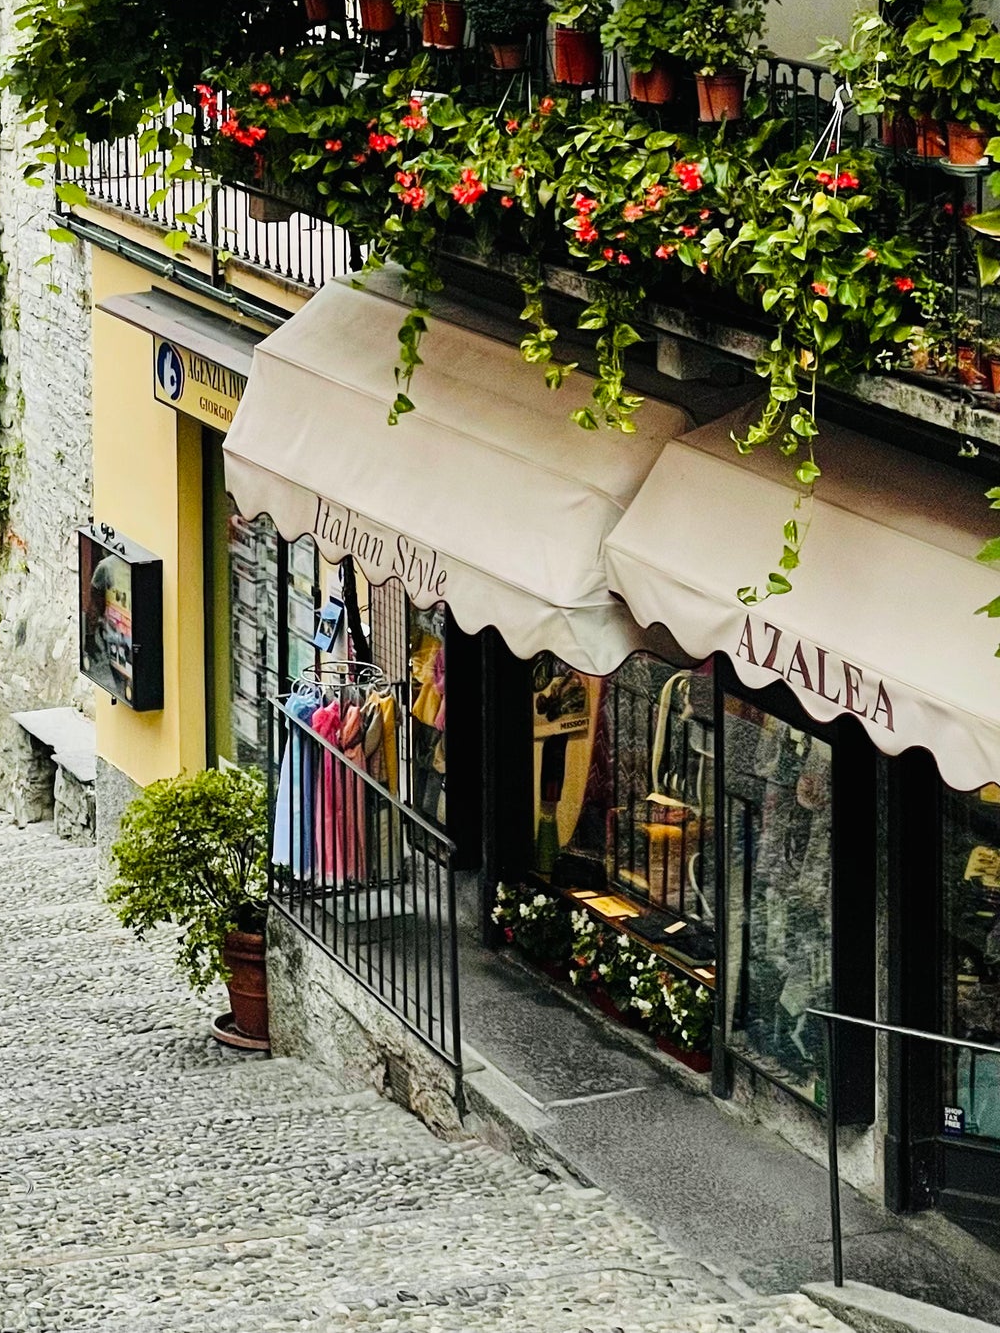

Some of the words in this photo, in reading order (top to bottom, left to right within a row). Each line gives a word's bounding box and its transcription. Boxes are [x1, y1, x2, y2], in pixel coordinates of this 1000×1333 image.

[187, 353, 227, 396] AGENZIA
[199, 396, 233, 424] GIORGIO
[313, 495, 383, 567] Italian
[391, 534, 447, 600] Style
[736, 614, 895, 733] AZALEA
[944, 1107, 963, 1116] SHOP
[944, 1113, 958, 1122] TAX
[944, 1120, 961, 1129] FREE
